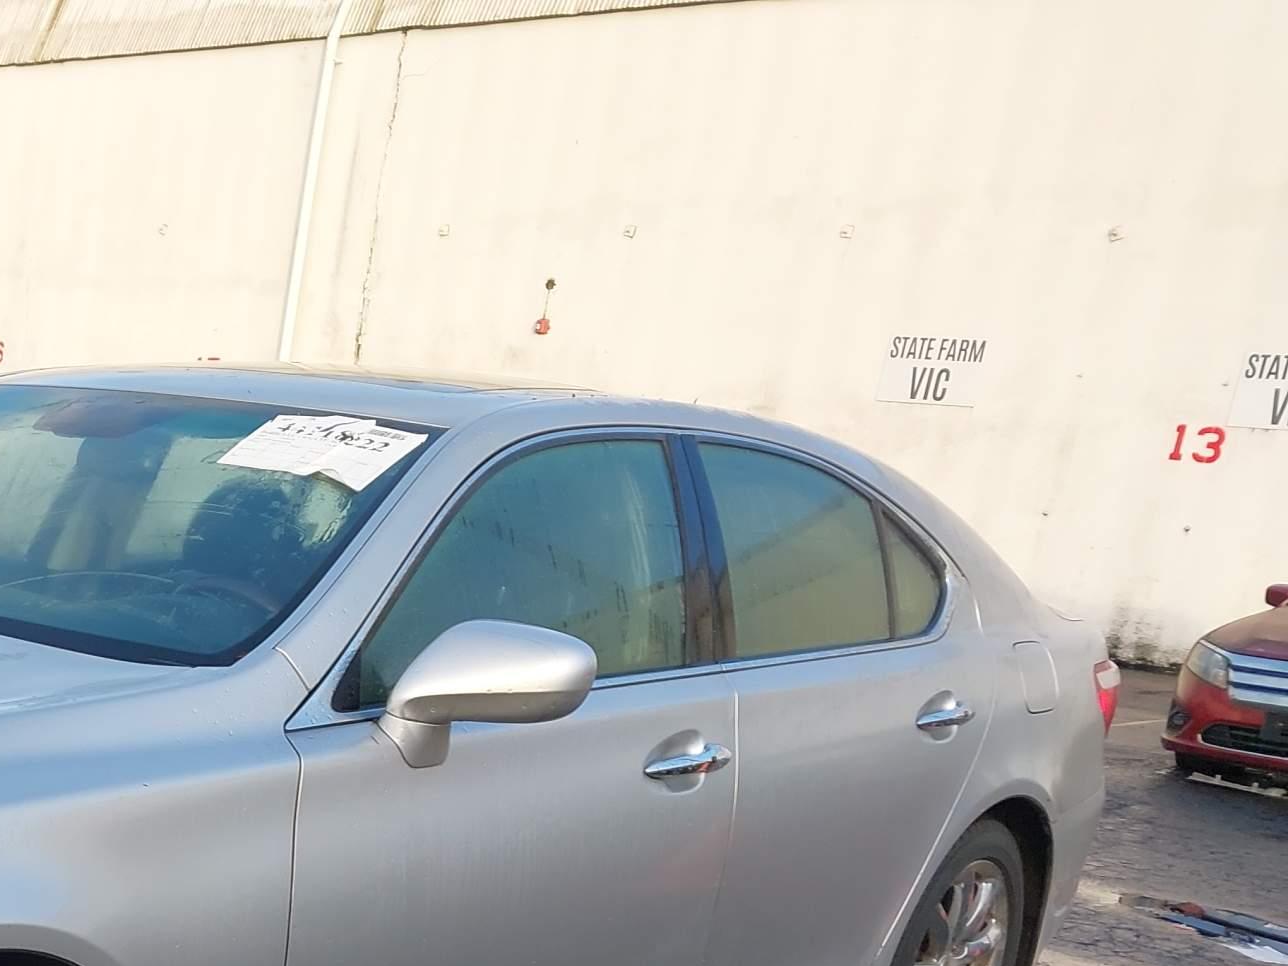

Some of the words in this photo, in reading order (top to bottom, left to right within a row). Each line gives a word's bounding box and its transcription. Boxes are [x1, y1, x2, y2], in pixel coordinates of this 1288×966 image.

[890, 336, 936, 360] STATE
[937, 338, 987, 363] FARM
[910, 366, 951, 401] VIC
[1168, 424, 1226, 464] 13
